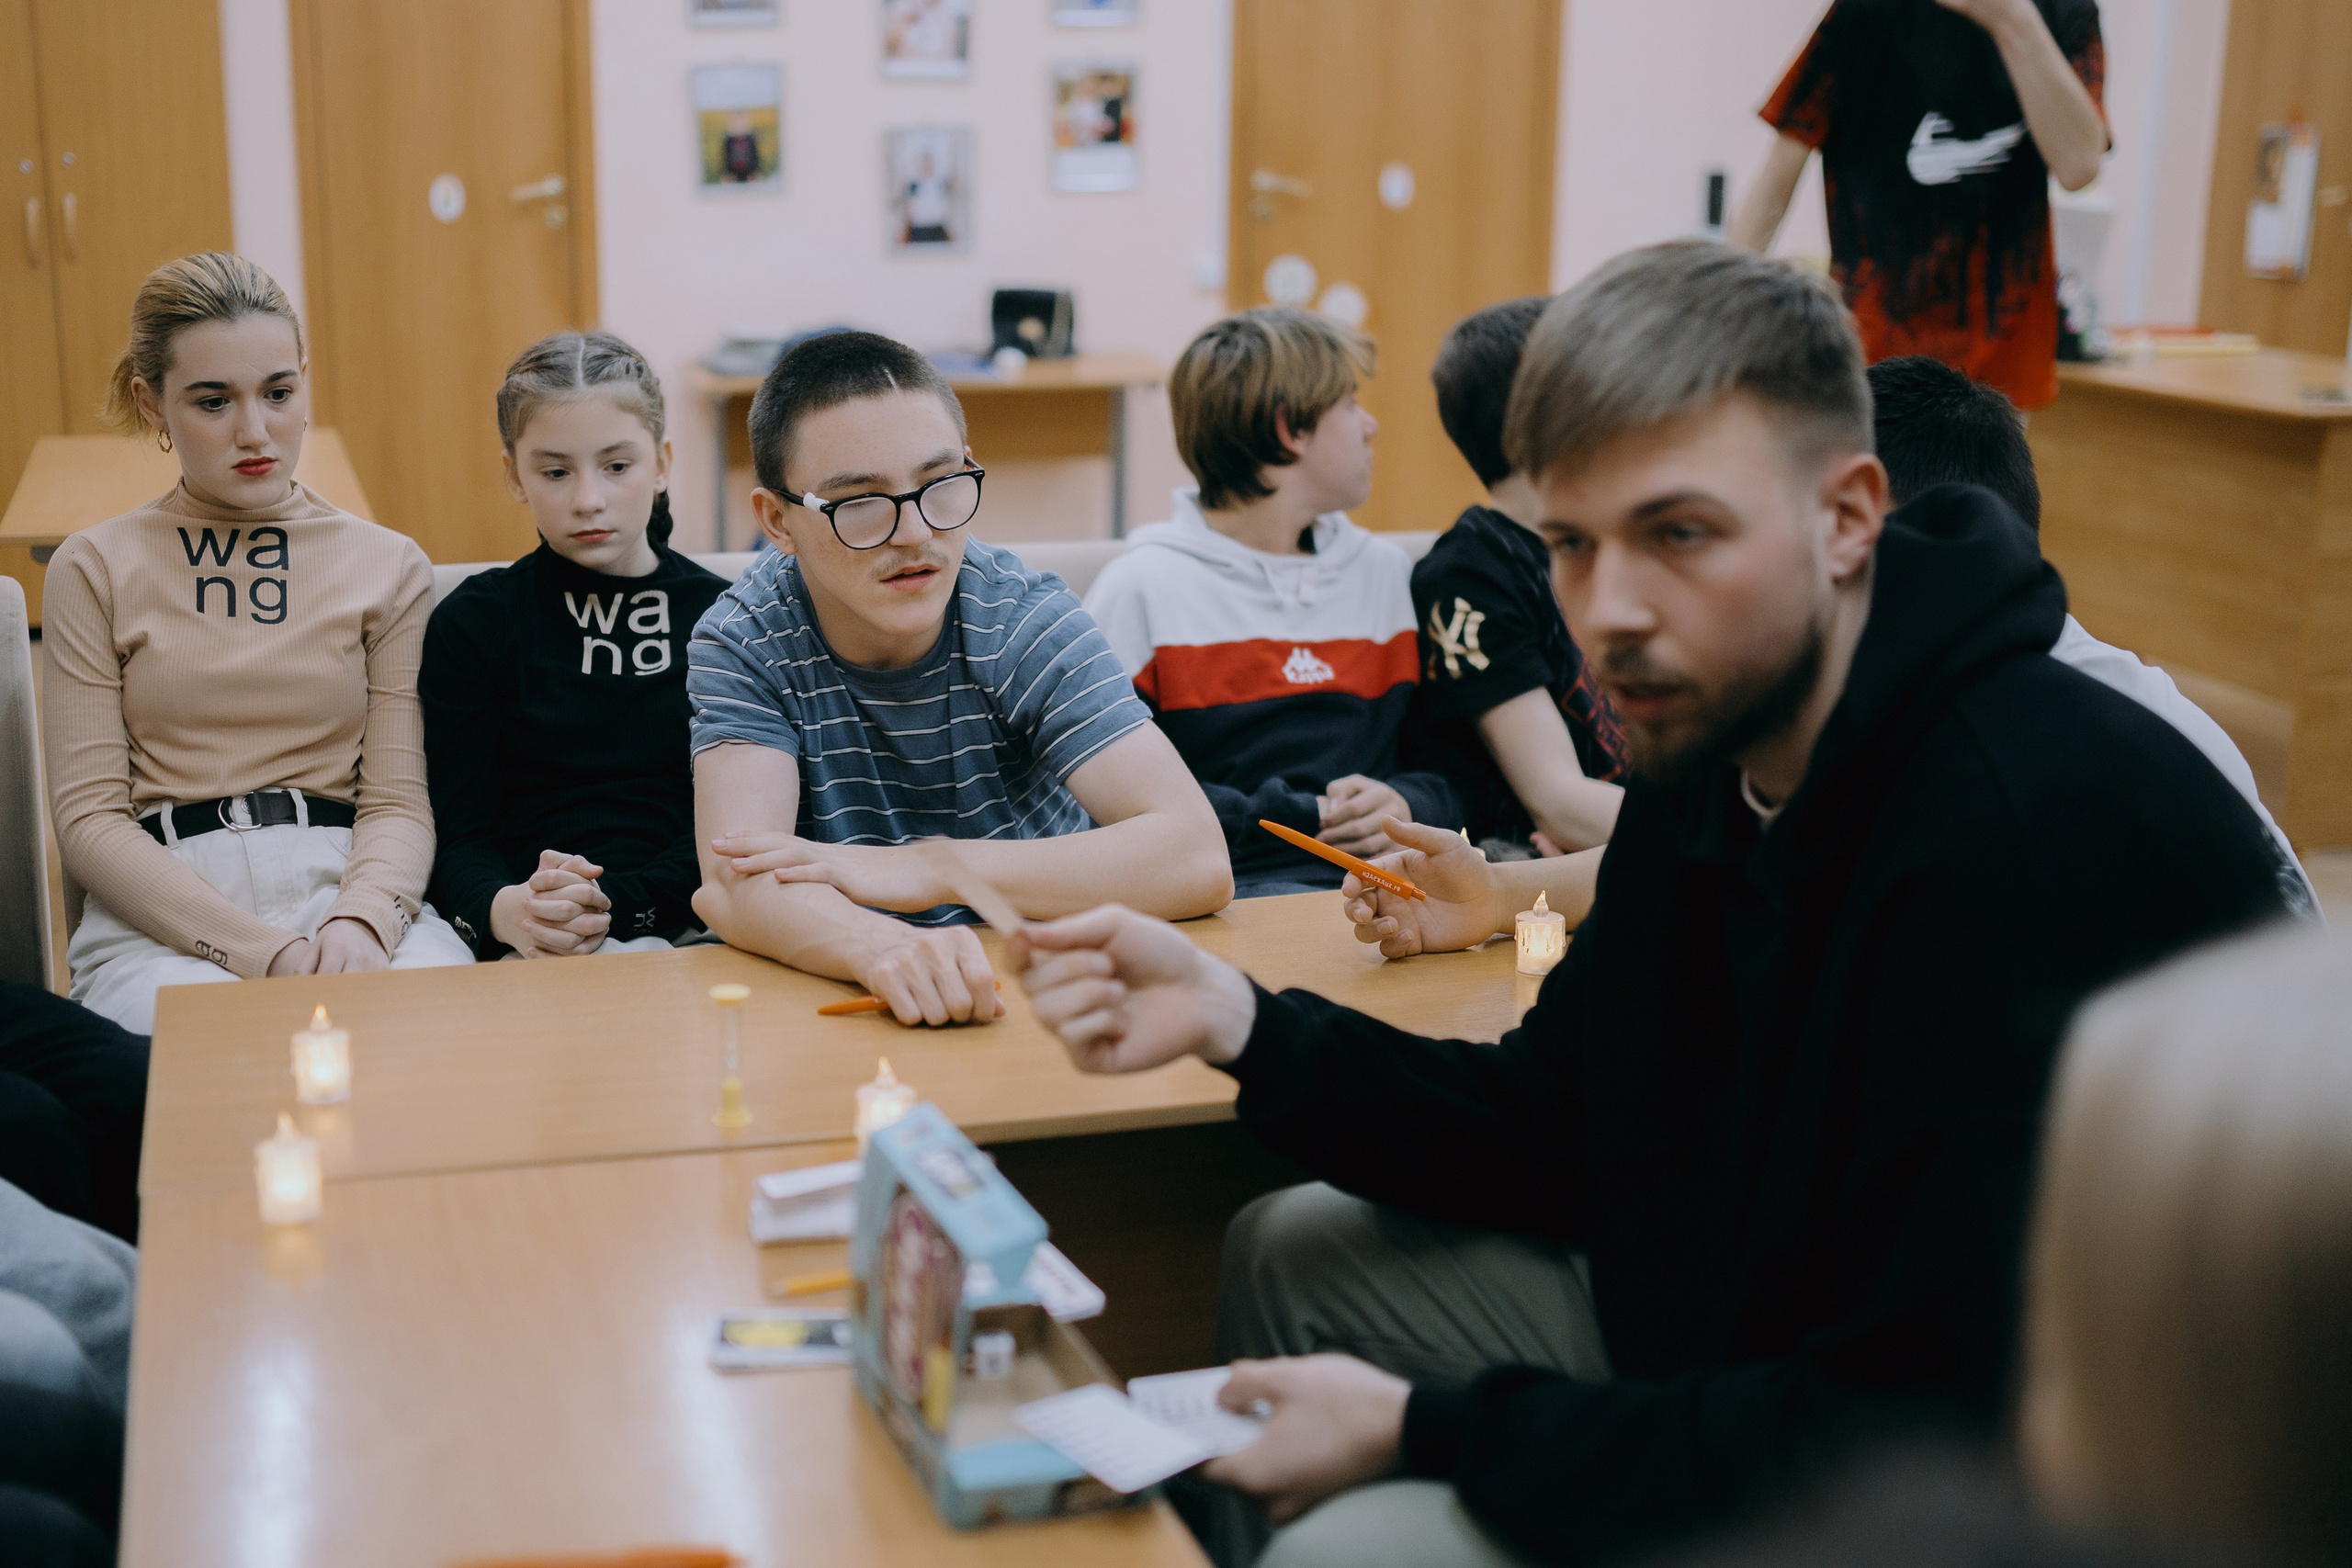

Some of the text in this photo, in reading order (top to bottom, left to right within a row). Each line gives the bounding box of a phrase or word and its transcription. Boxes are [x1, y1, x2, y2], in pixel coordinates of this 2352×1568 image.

[176, 526, 289, 570] wa
[196, 576, 288, 625] ng
[564, 590, 671, 634] wa
[582, 637, 672, 676] ng
